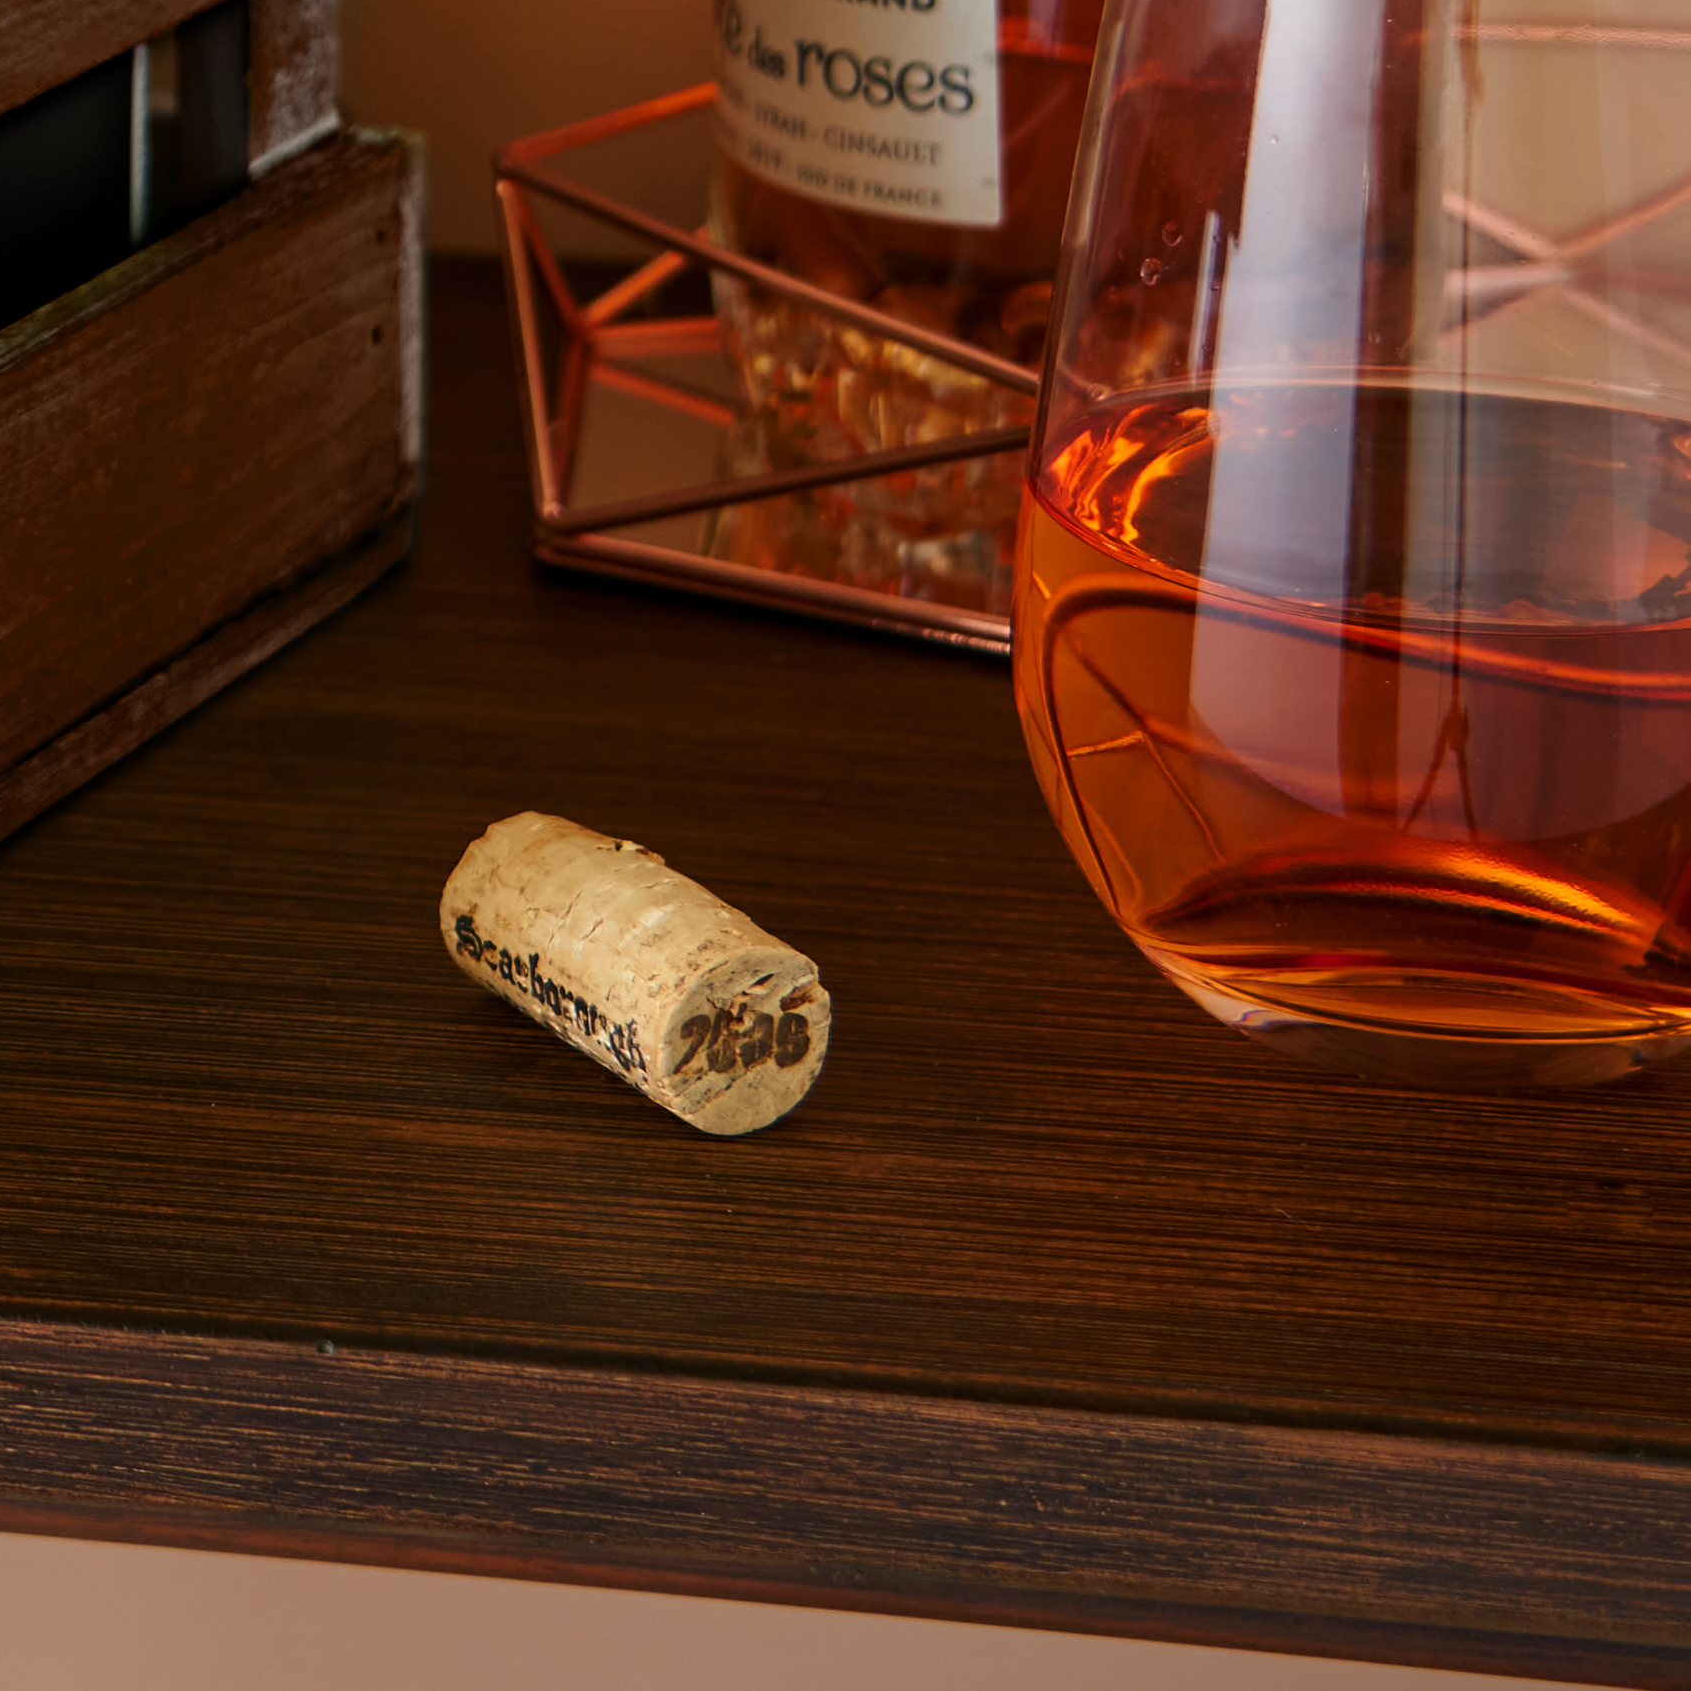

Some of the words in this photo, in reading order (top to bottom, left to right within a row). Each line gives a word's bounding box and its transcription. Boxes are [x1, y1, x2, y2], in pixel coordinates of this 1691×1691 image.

[747, 24, 786, 80] des
[794, 36, 975, 116] roses
[824, 125, 942, 168] CINSAULT
